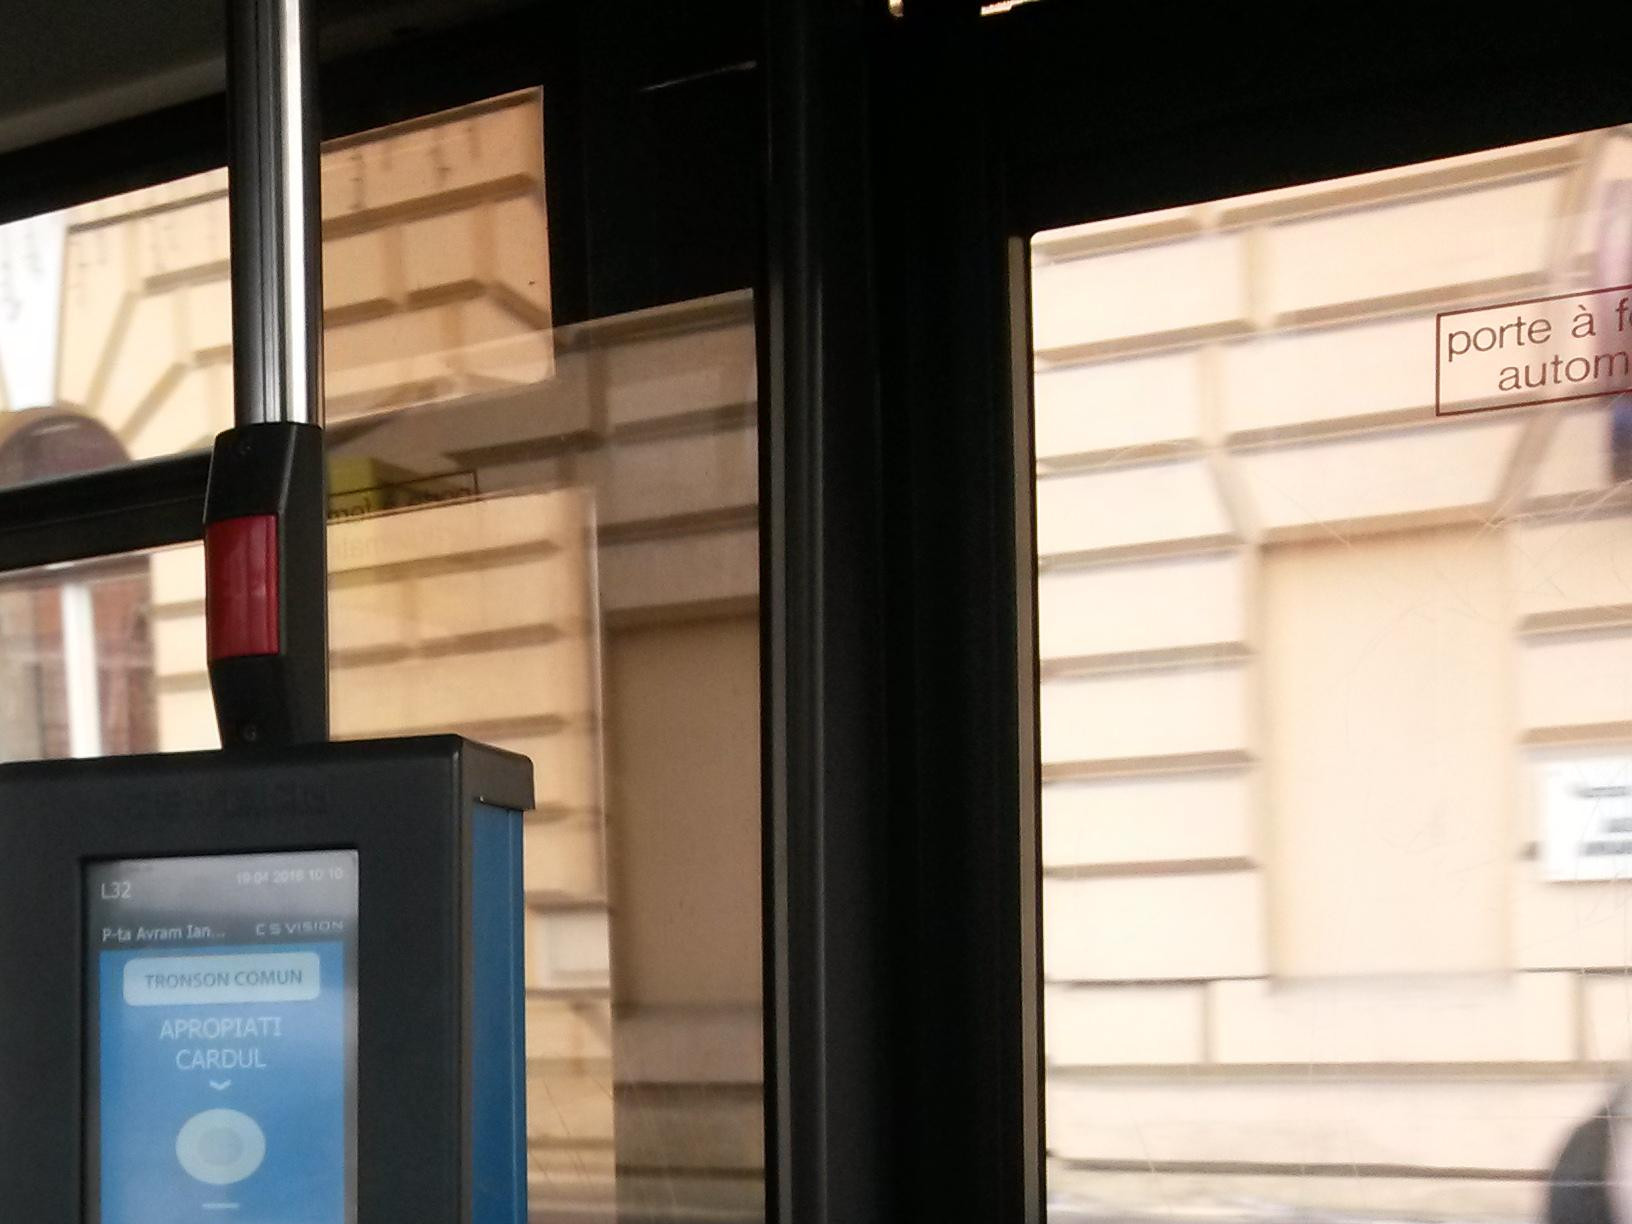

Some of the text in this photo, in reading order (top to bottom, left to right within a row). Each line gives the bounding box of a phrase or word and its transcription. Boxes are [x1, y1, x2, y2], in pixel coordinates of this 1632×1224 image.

[1448, 316, 1552, 362] porte
[1571, 304, 1596, 338] à
[1497, 351, 1629, 391] autom
[101, 880, 131, 900] L32
[102, 929, 132, 943] P-ta
[136, 926, 183, 941] Avram
[287, 920, 344, 934] VISION
[145, 969, 303, 989] TRONSON COMUN
[160, 1016, 283, 1040] APROPIATI
[175, 1048, 267, 1070] CARDUL
